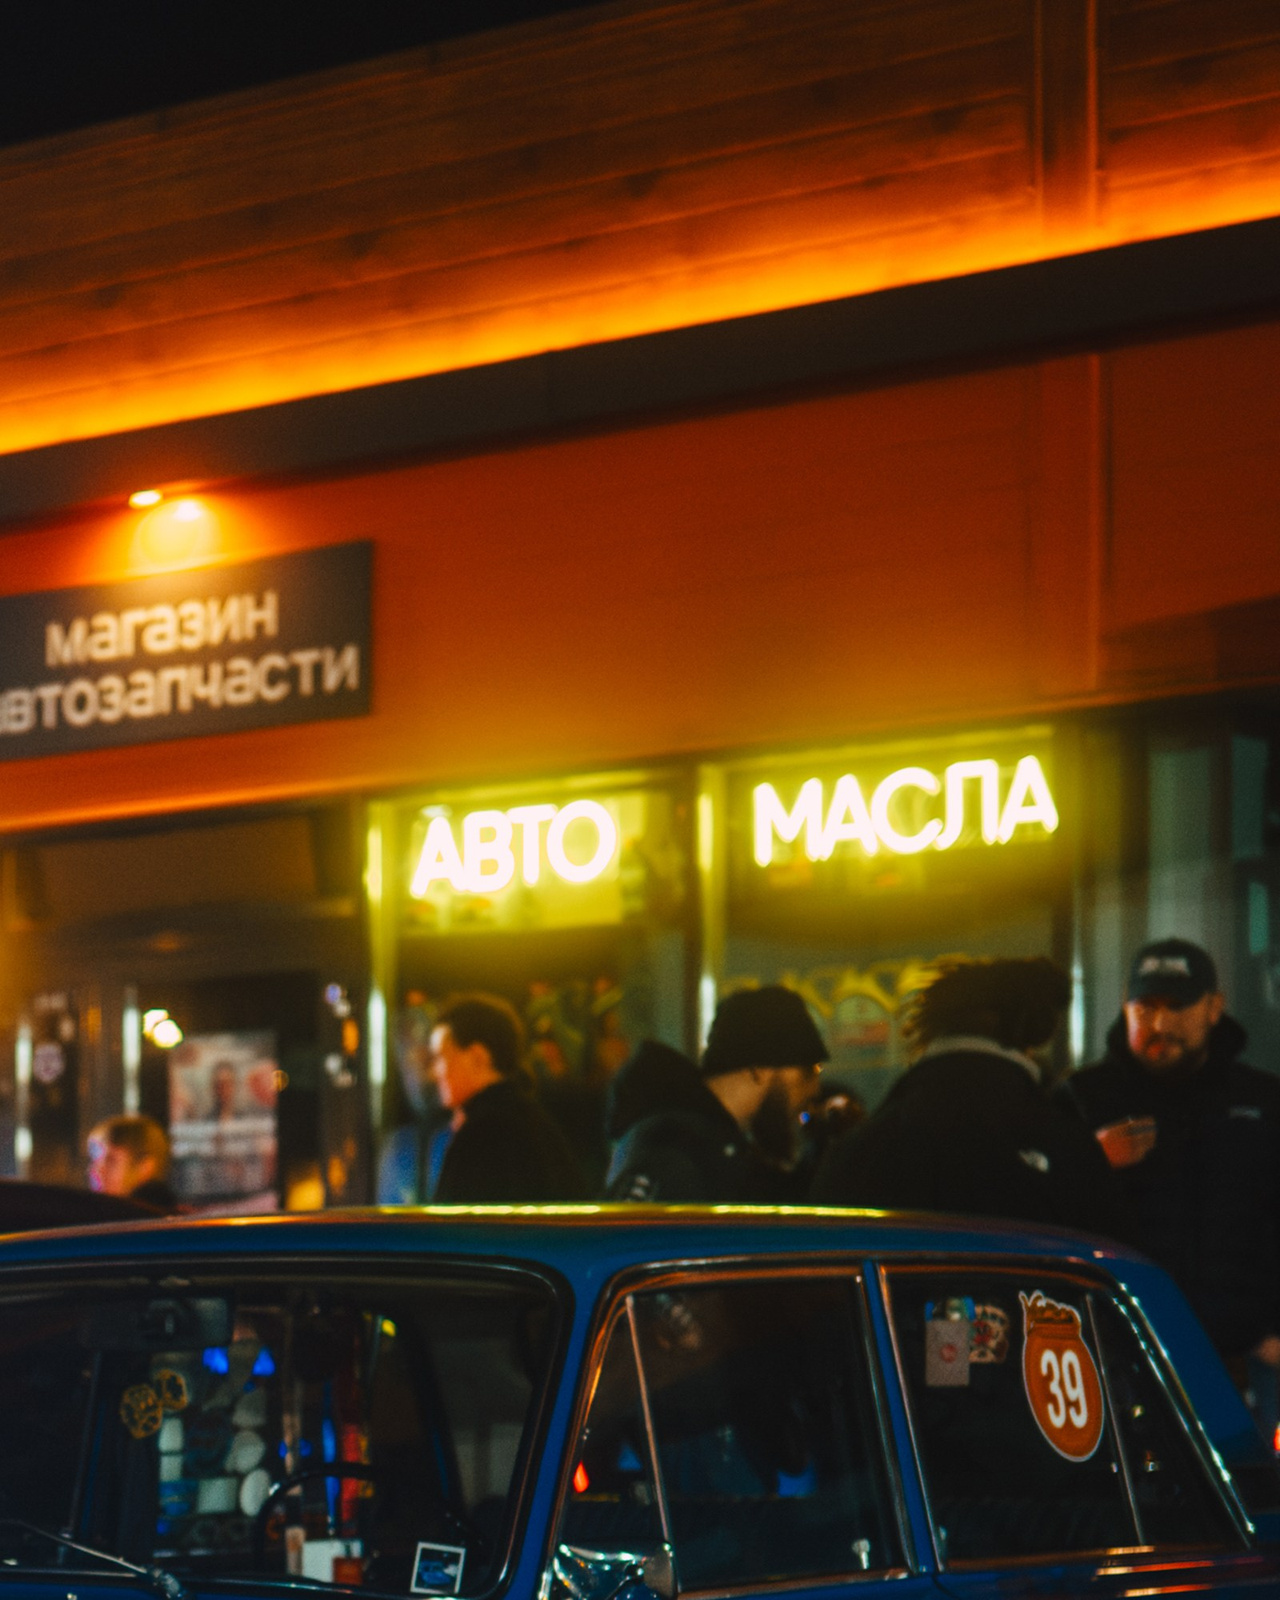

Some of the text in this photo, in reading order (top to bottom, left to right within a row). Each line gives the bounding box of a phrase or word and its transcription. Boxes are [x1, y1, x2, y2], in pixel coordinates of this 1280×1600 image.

[43, 589, 280, 669] магазин
[410, 755, 1060, 898] АВТО МАСЛА
[1040, 1349, 1088, 1429] 39
